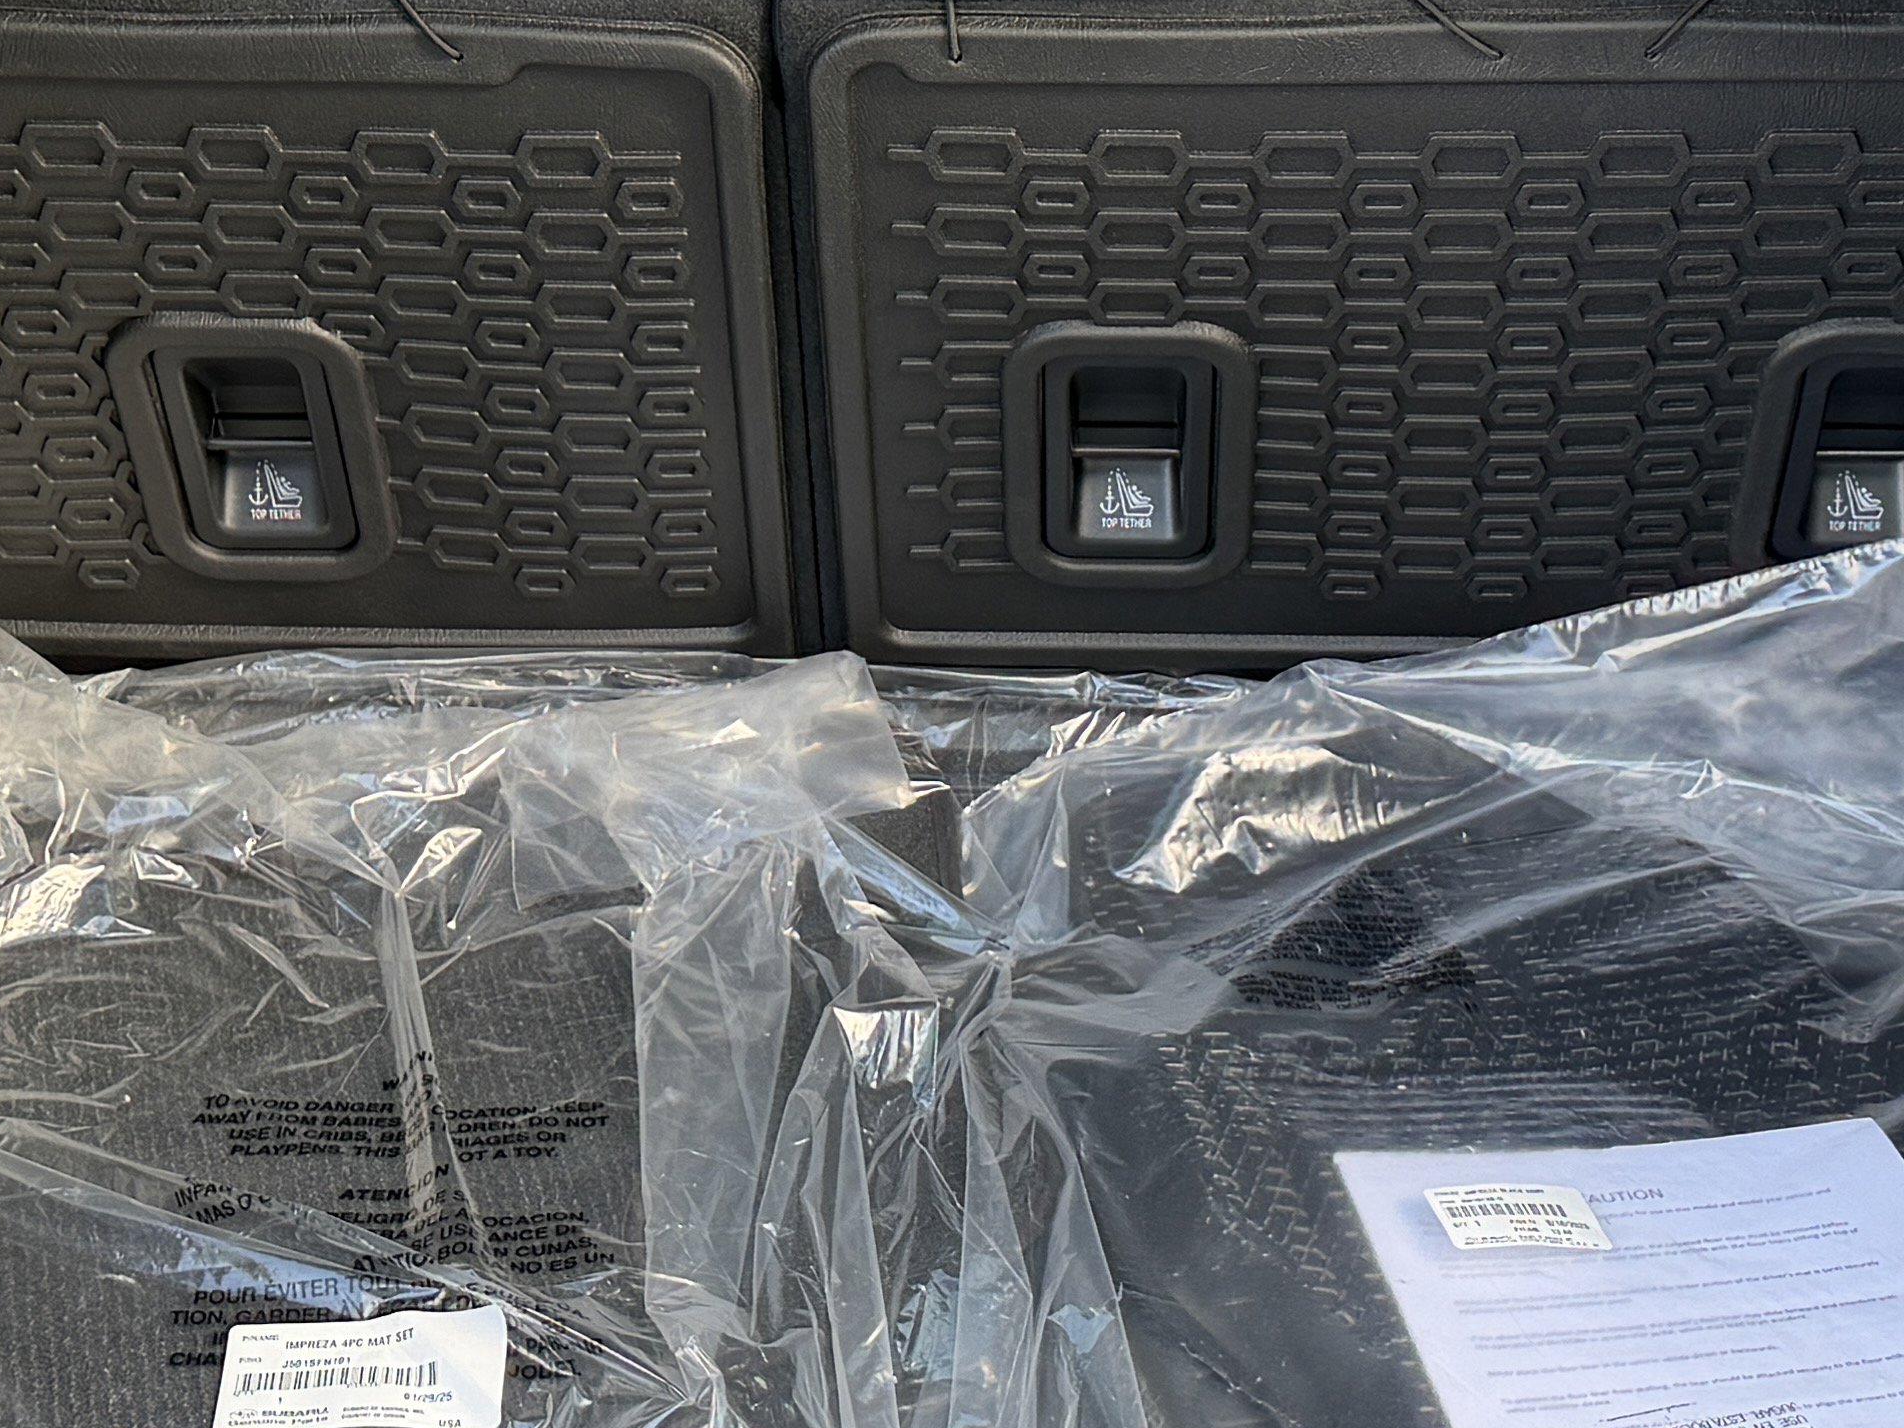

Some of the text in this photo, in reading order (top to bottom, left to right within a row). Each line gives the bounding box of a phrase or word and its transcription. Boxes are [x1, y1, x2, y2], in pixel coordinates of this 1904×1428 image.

[249, 509, 302, 520] TOP TETHER
[1101, 518, 1152, 528] TOP TETHER
[1829, 521, 1881, 531] TOP TETHER
[205, 1094, 394, 1113] TO AVOID DANGER
[193, 1111, 250, 1124] AWAY
[322, 1117, 402, 1127] BABIES
[529, 1117, 560, 1128] DO
[566, 1116, 610, 1128] NOT
[229, 1129, 270, 1140] USE
[277, 1128, 297, 1137] IN
[537, 1132, 567, 1142] OR
[353, 1146, 402, 1158] THIS
[493, 1148, 508, 1160] A
[513, 1146, 559, 1158] TOY.
[1588, 1187, 1664, 1204] AUTION
[510, 1252, 615, 1274] NO ES UN
[194, 1289, 255, 1304] POUR
[264, 1278, 339, 1302] ÉVITER
[236, 1308, 332, 1322] GARDER
[286, 1340, 337, 1349] IMPREZA
[341, 1338, 363, 1347] 4PC
[368, 1335, 391, 1346] MAT
[396, 1327, 414, 1343] SET
[262, 1407, 329, 1417] SUBARU
[439, 1419, 461, 1428] USA
